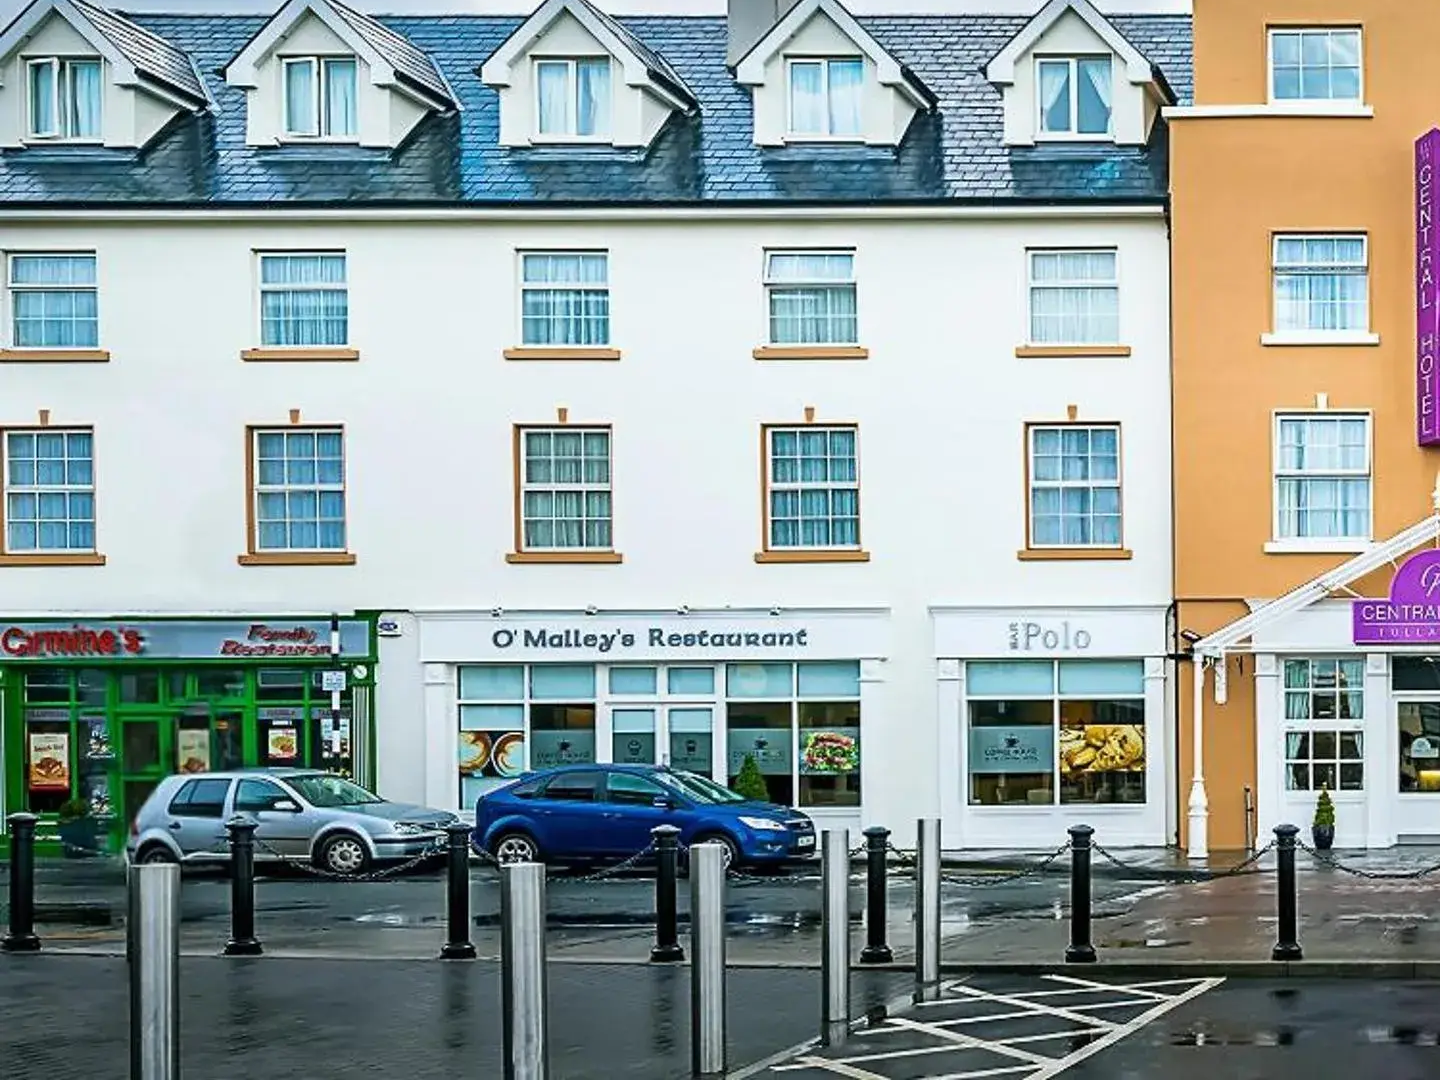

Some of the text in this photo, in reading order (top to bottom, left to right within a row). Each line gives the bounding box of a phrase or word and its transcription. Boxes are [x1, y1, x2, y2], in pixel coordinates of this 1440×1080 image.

[1419, 164, 1434, 435] CENTRAL HOTEL
[247, 624, 318, 643] Family
[648, 628, 808, 648] Restaurant
[1024, 621, 1091, 650] Polo
